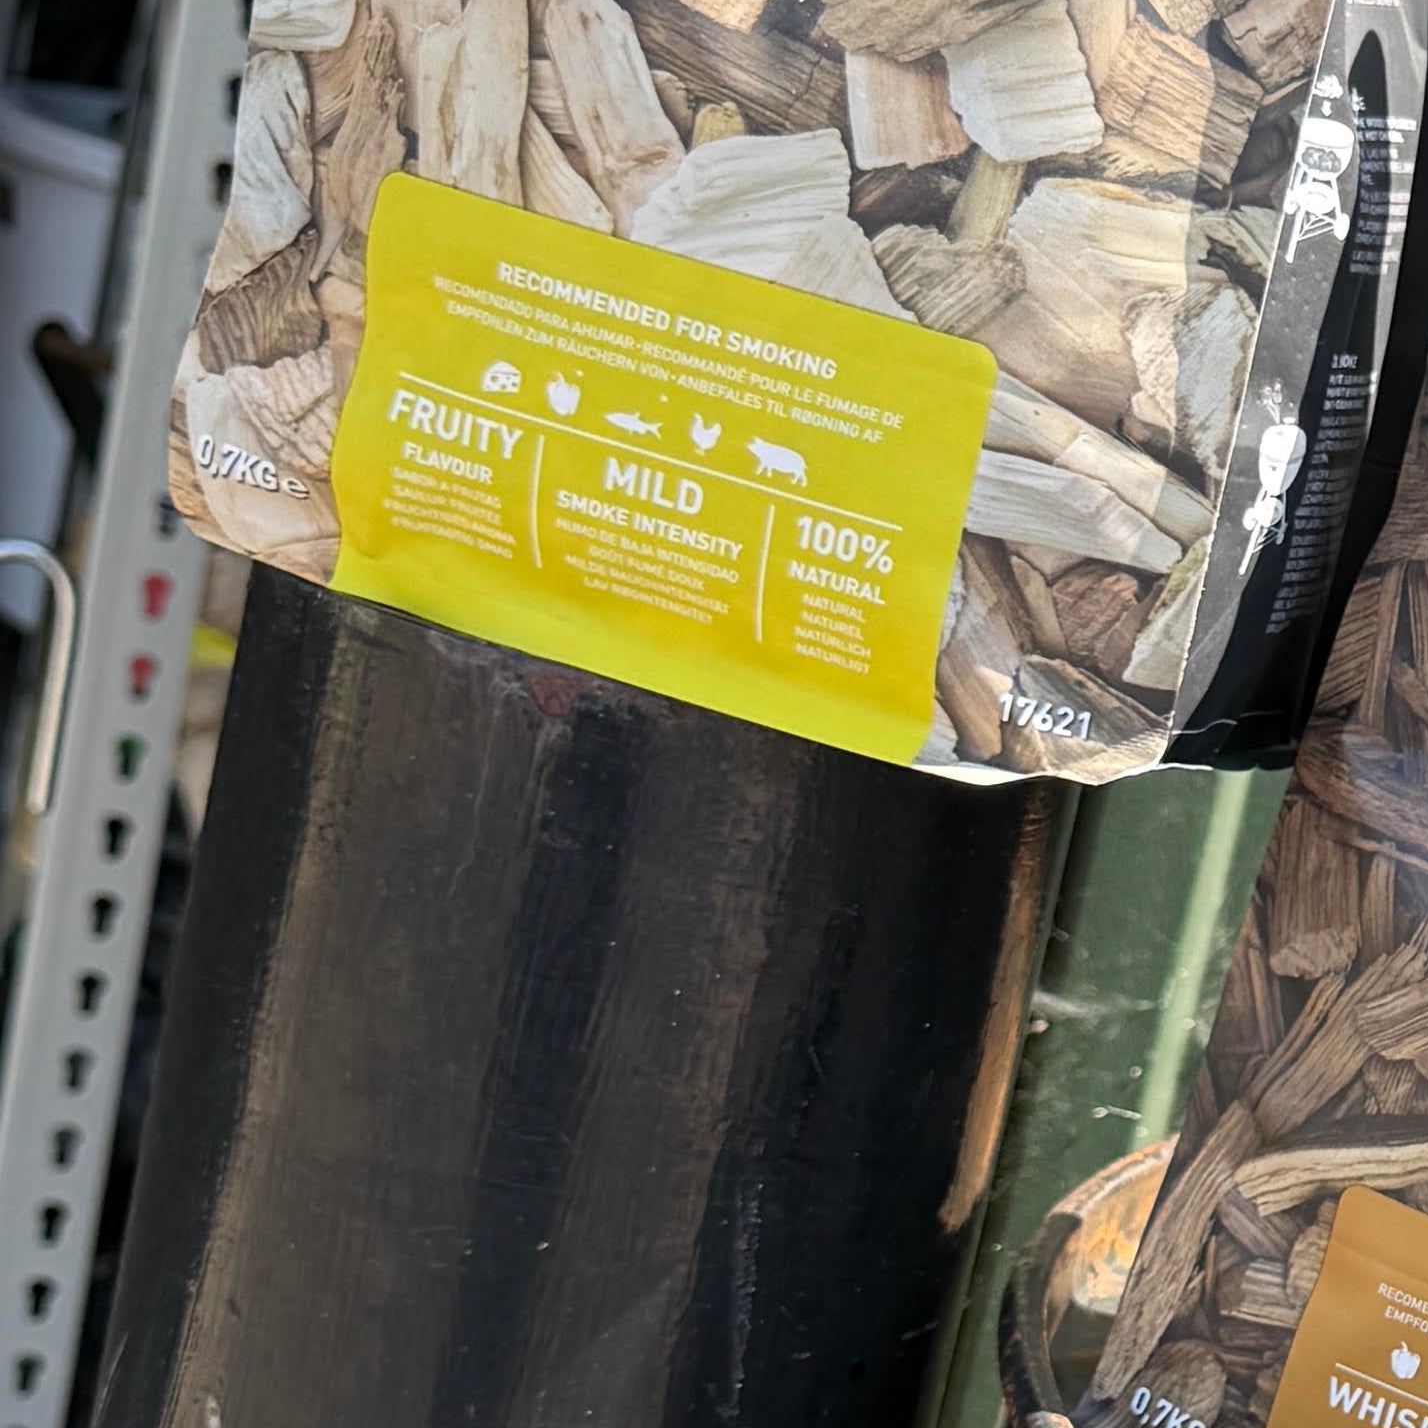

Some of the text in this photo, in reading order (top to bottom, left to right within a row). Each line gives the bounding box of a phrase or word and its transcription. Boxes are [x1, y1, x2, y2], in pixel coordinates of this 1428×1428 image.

[495, 263, 837, 380] RECOMMENDED FOR SMOKING
[387, 389, 893, 575] FRUITY MILD 100%
[401, 442, 493, 485] FLAVOUR
[555, 489, 628, 529] SMOKE
[632, 508, 743, 561] INTENSITY
[789, 560, 885, 605] NATURAL
[998, 693, 1092, 740] 17621
